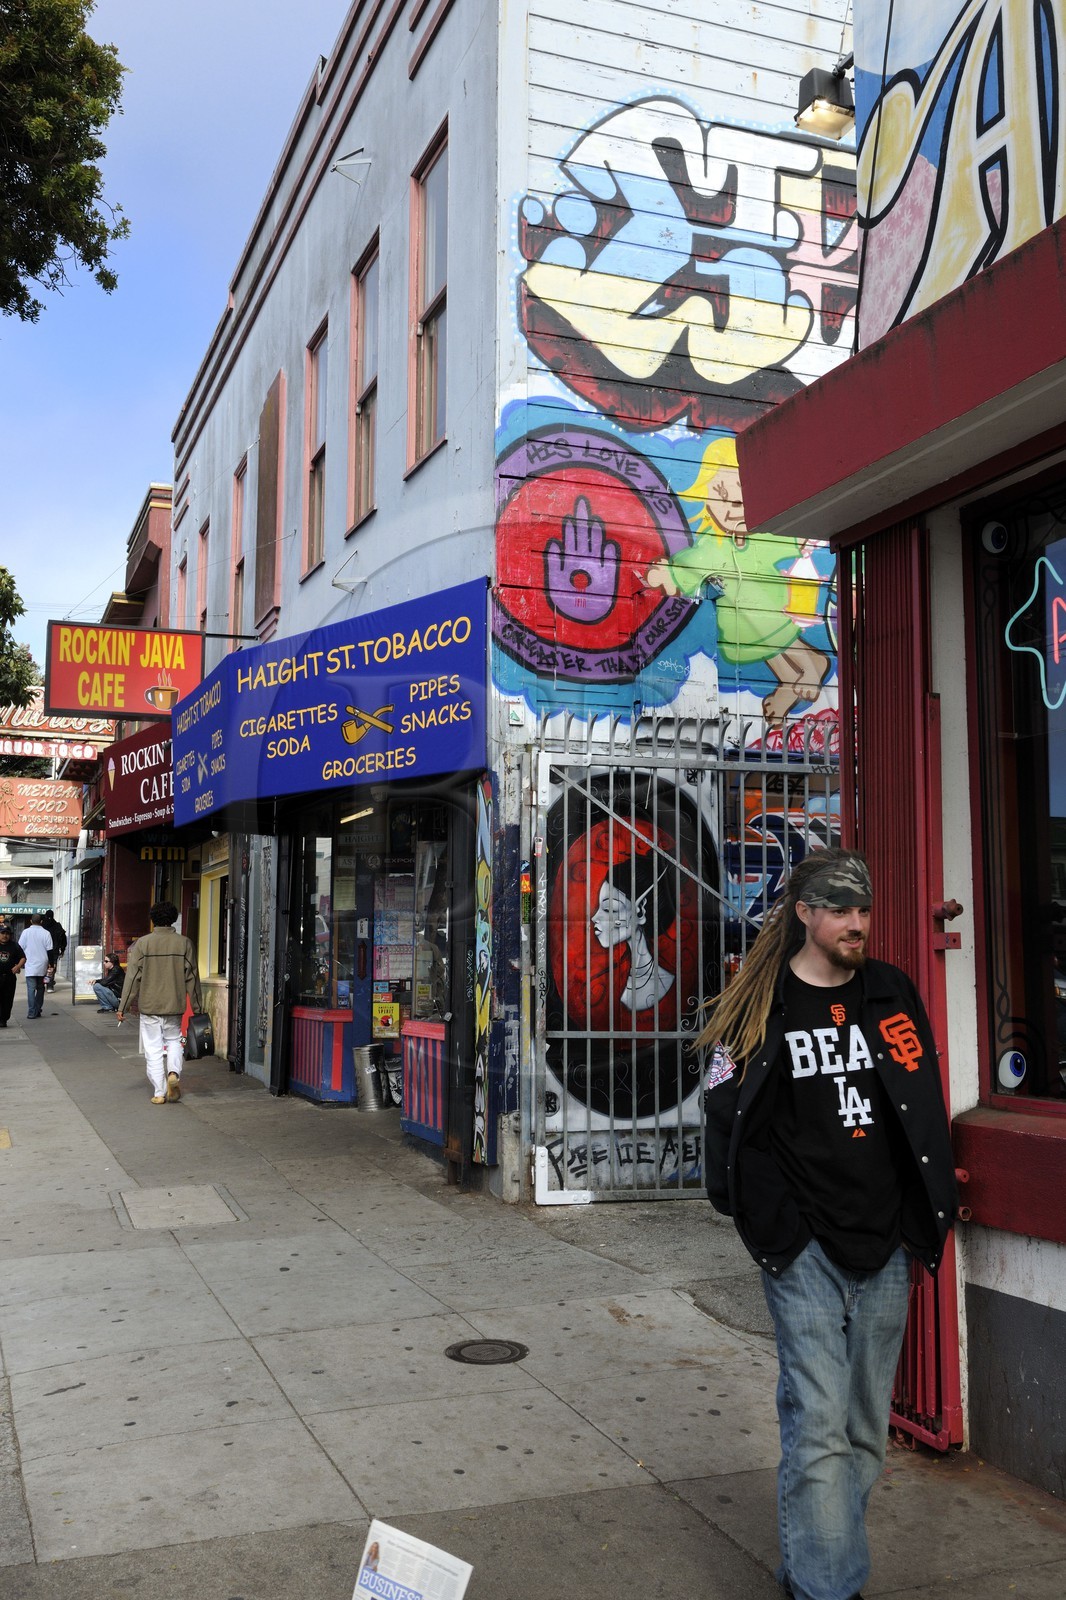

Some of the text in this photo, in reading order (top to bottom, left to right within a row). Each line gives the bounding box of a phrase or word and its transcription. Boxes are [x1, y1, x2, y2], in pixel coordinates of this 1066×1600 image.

[526, 438, 673, 515] HIS LOVE IS
[59, 628, 186, 670] ROCKIN' JAVA
[237, 616, 472, 693] HAIGHT ST. TOBACCO
[501, 623, 592, 673] GREATER
[644, 620, 668, 646] OUR
[78, 672, 125, 708] CAFE
[409, 674, 461, 703] PIPES
[176, 705, 193, 737] HAIGHT
[199, 680, 221, 718] TOBACCO
[239, 703, 338, 738] CIGARETTES
[401, 701, 472, 734] SNACKS
[49, 743, 68, 757] TO
[72, 744, 94, 759] GO
[266, 735, 311, 759] SODA
[322, 747, 417, 781] GROCERIES
[17, 784, 82, 799] MEXICAN
[27, 798, 68, 813] FOOD
[109, 816, 132, 829] Sandwiches
[134, 812, 152, 825] Espresso
[154, 807, 165, 819] Soup
[140, 846, 186, 861] ATM
[830, 1003, 846, 1026] SF
[878, 1012, 924, 1073] SF
[833, 1076, 875, 1128] LA
